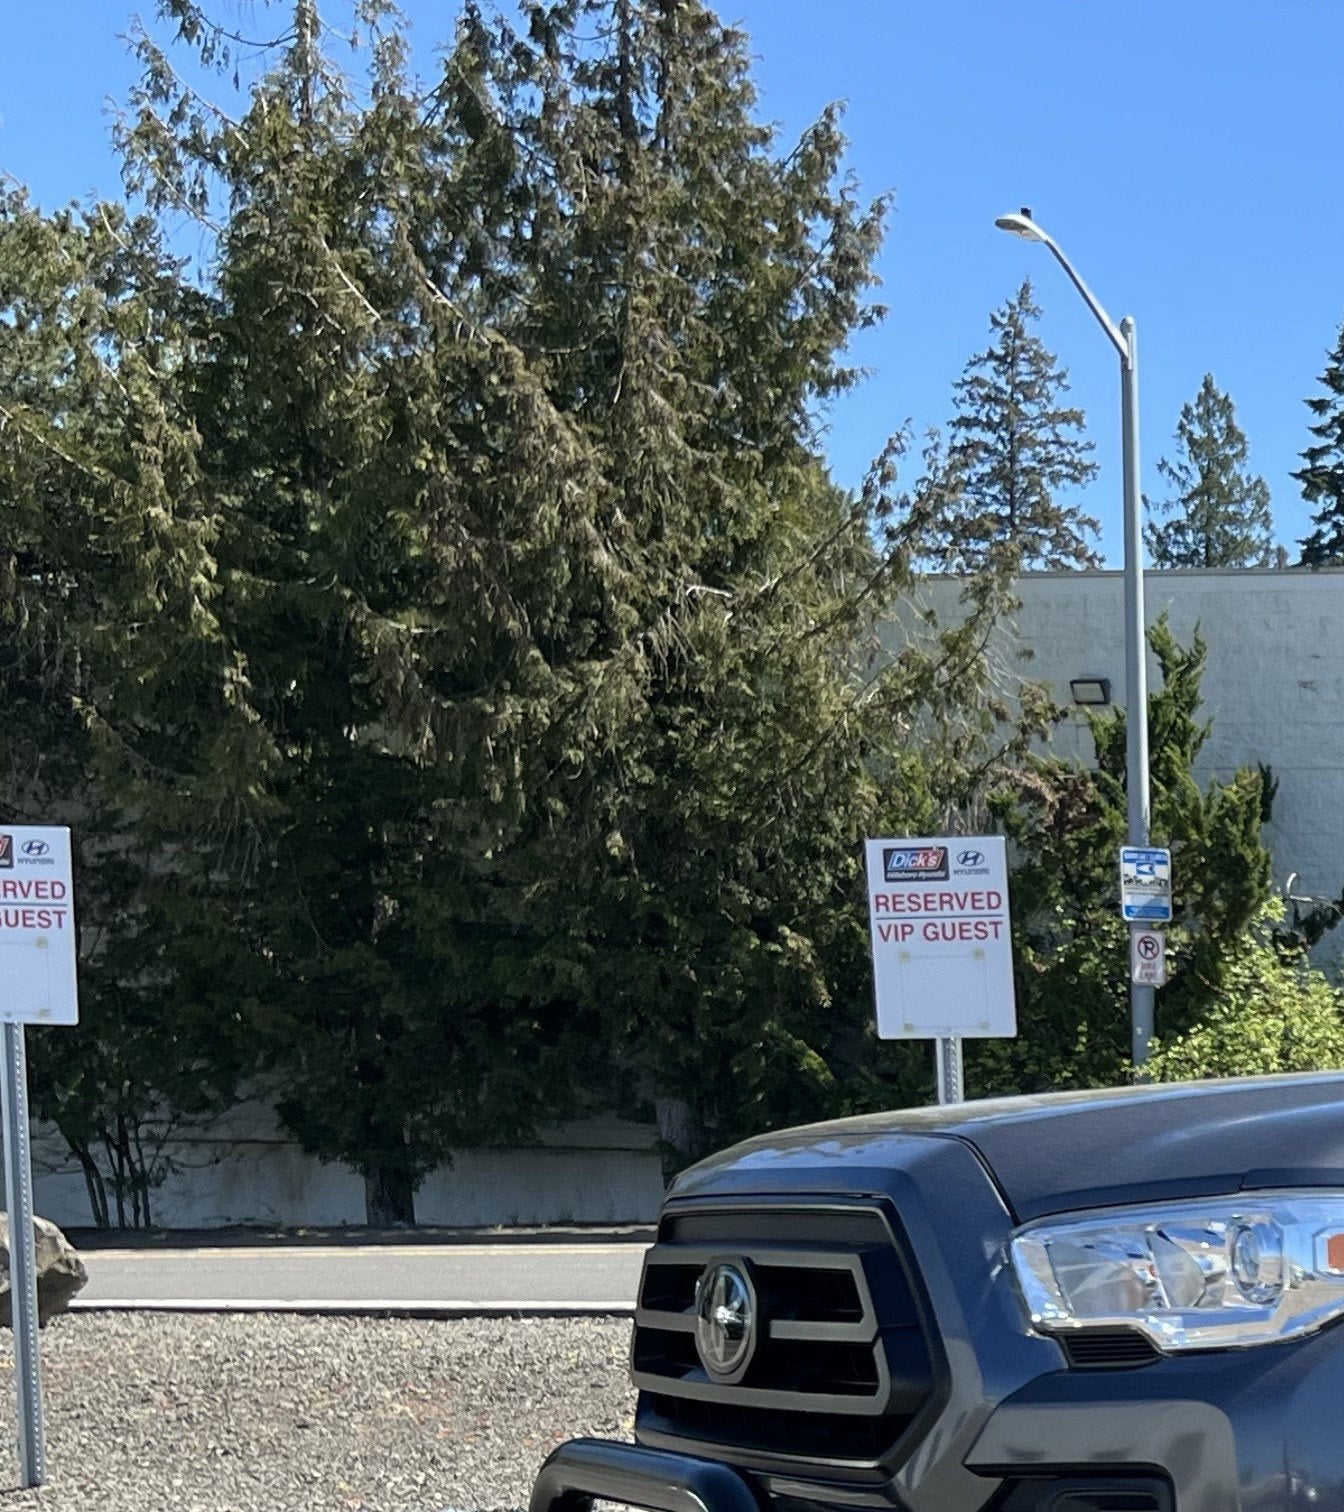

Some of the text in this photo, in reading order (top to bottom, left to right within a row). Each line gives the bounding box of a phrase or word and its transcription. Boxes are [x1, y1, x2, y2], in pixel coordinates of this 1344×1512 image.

[1, 880, 66, 899] RVED
[875, 891, 1002, 913] RESERVED
[0, 909, 67, 929] UEST
[877, 920, 1002, 942] VIP GUEST
